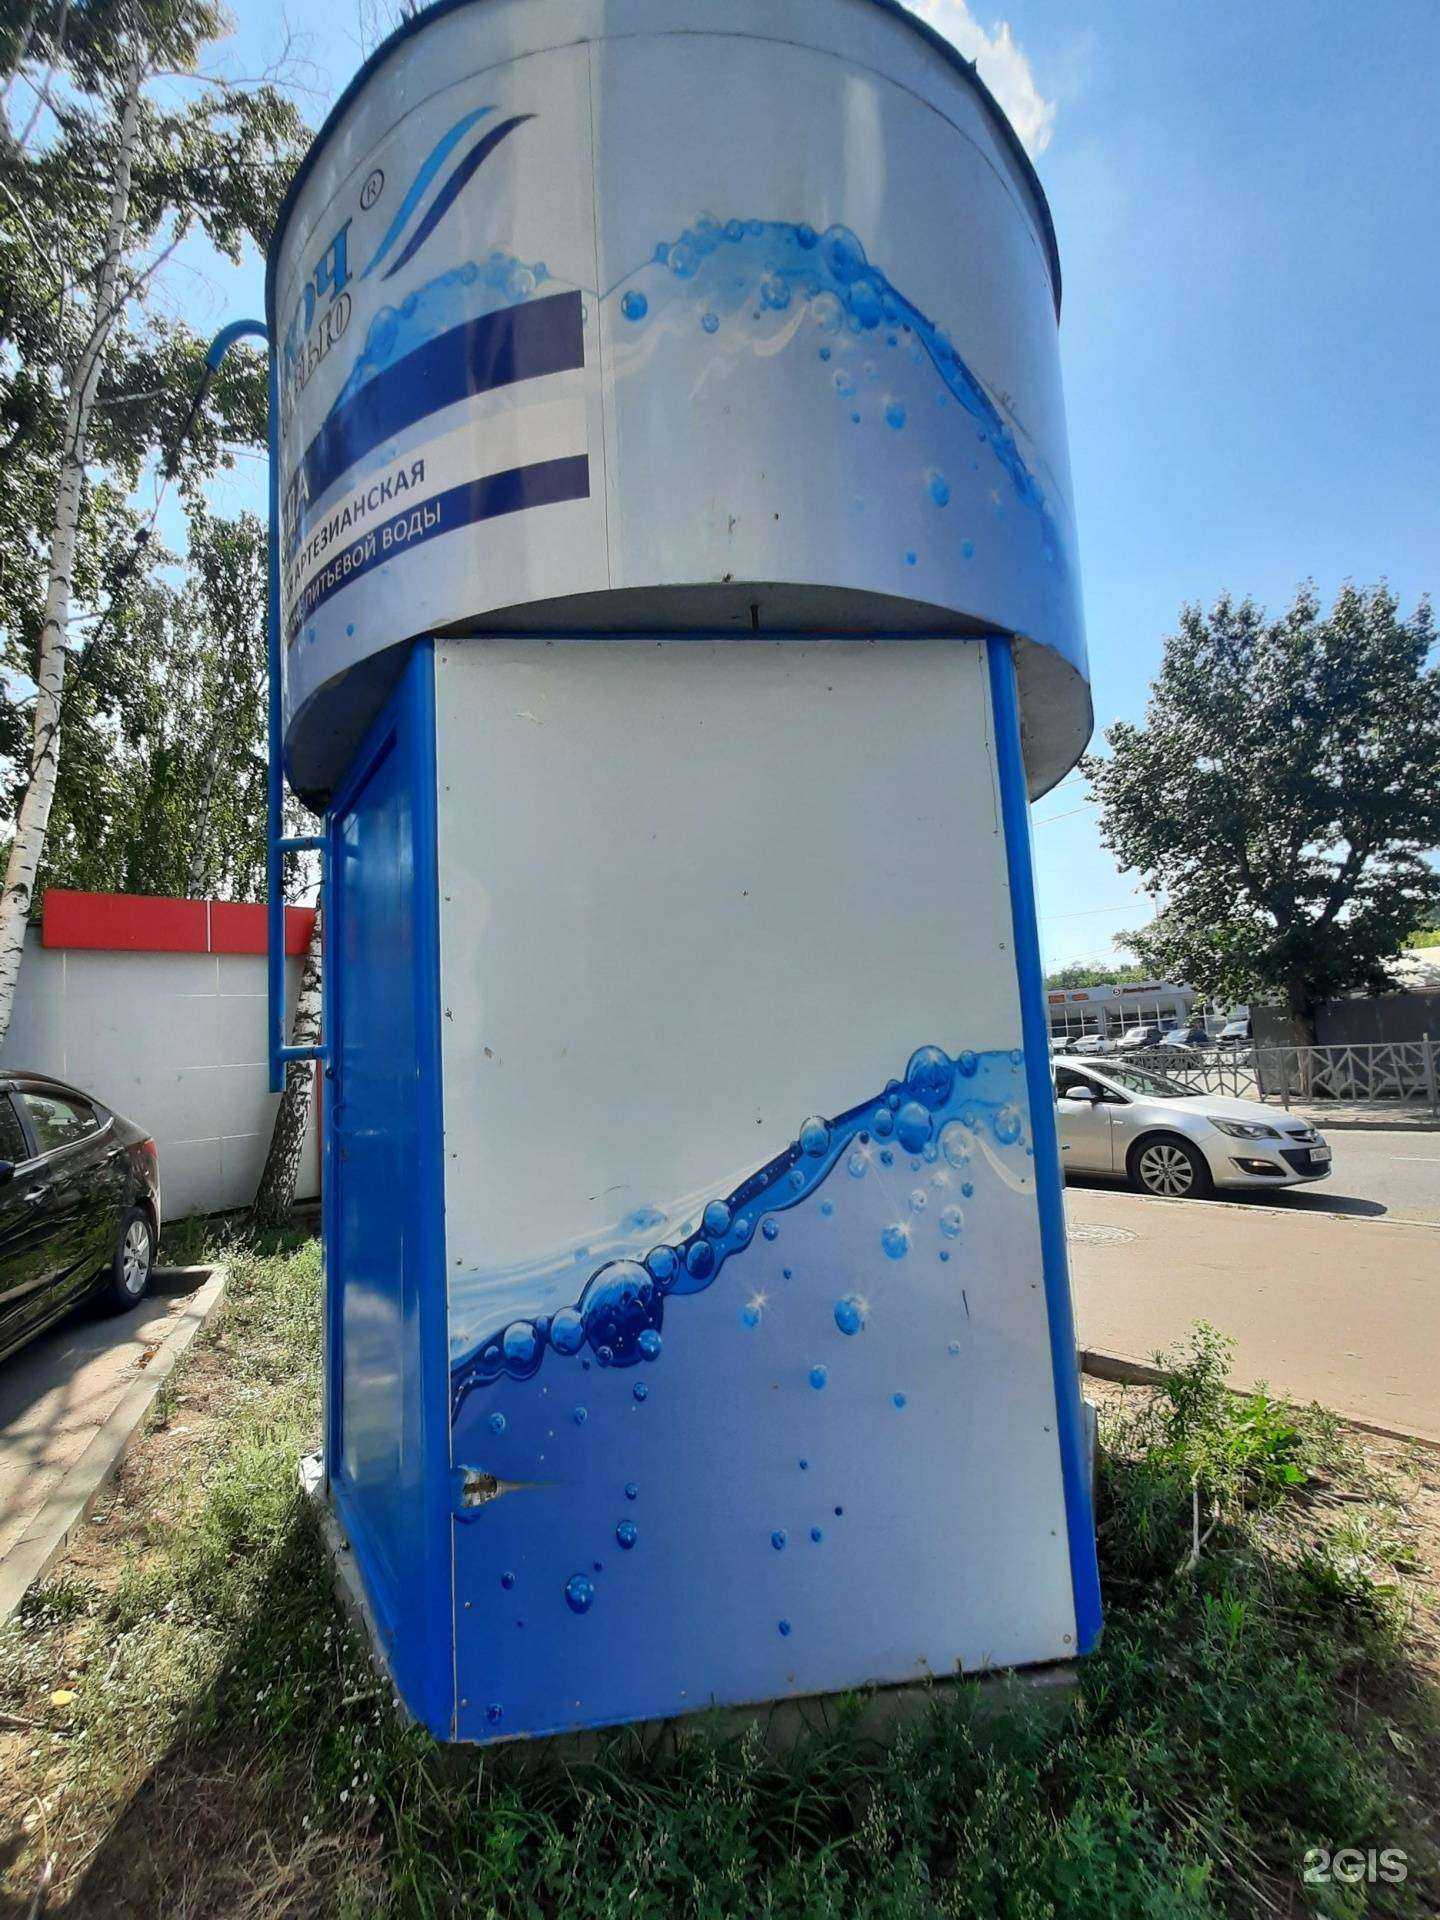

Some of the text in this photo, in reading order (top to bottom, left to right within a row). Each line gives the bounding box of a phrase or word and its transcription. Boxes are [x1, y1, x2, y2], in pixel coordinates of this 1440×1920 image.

[294, 459, 425, 585] АРТЕЗИАНСКАЯ
[304, 534, 376, 608] ПИТЬЕВОЙ
[382, 502, 441, 549] ВОДЫ
